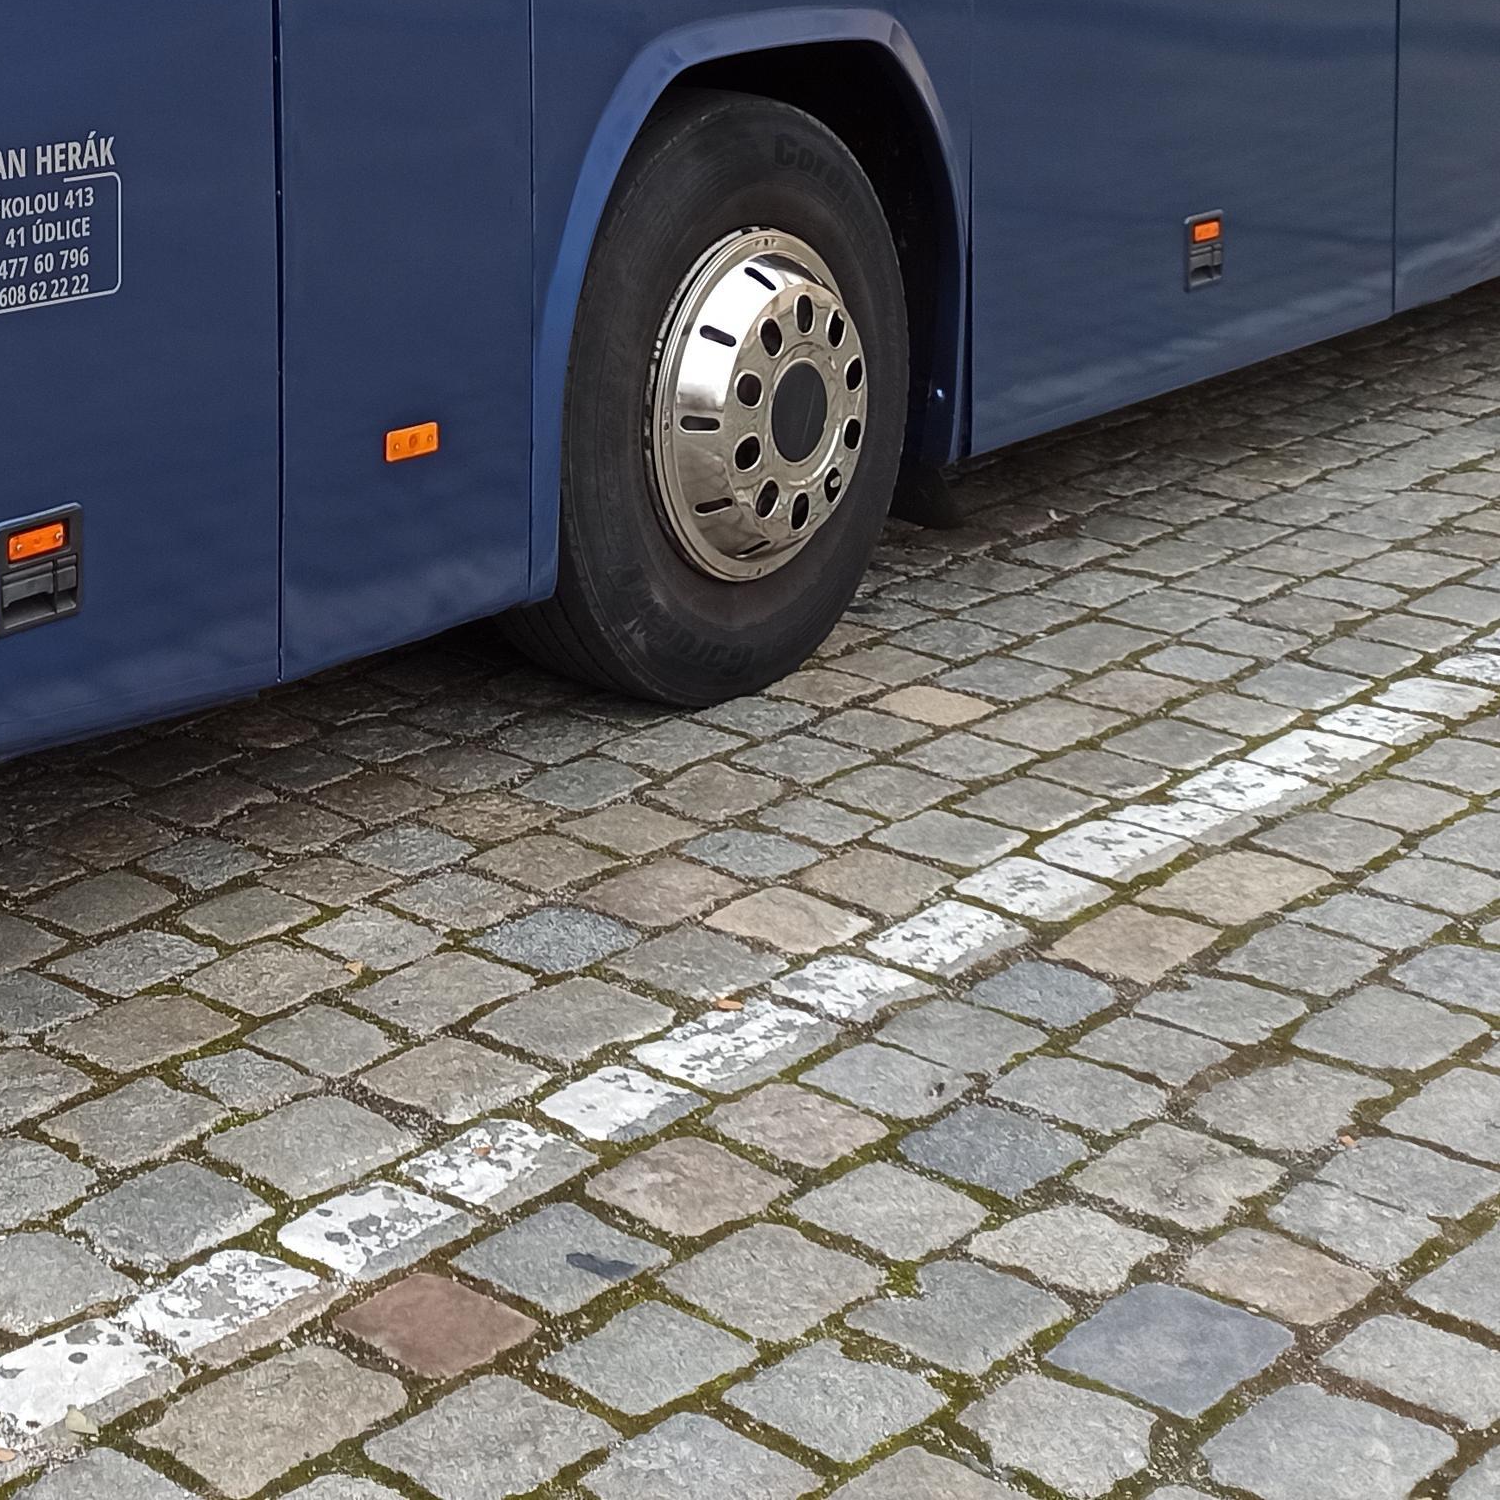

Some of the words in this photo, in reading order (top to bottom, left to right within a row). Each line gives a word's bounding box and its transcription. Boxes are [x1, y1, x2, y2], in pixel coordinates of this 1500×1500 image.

[36, 130, 116, 176] HERÁK
[63, 186, 95, 210] 413
[5, 226, 25, 249] 41
[32, 216, 91, 245] ÚDLICE
[34, 252, 54, 274] 60
[59, 246, 90, 271] 796
[0, 284, 26, 308] 608
[29, 280, 48, 301] 62
[50, 276, 68, 299] 22
[71, 272, 90, 294] 22
